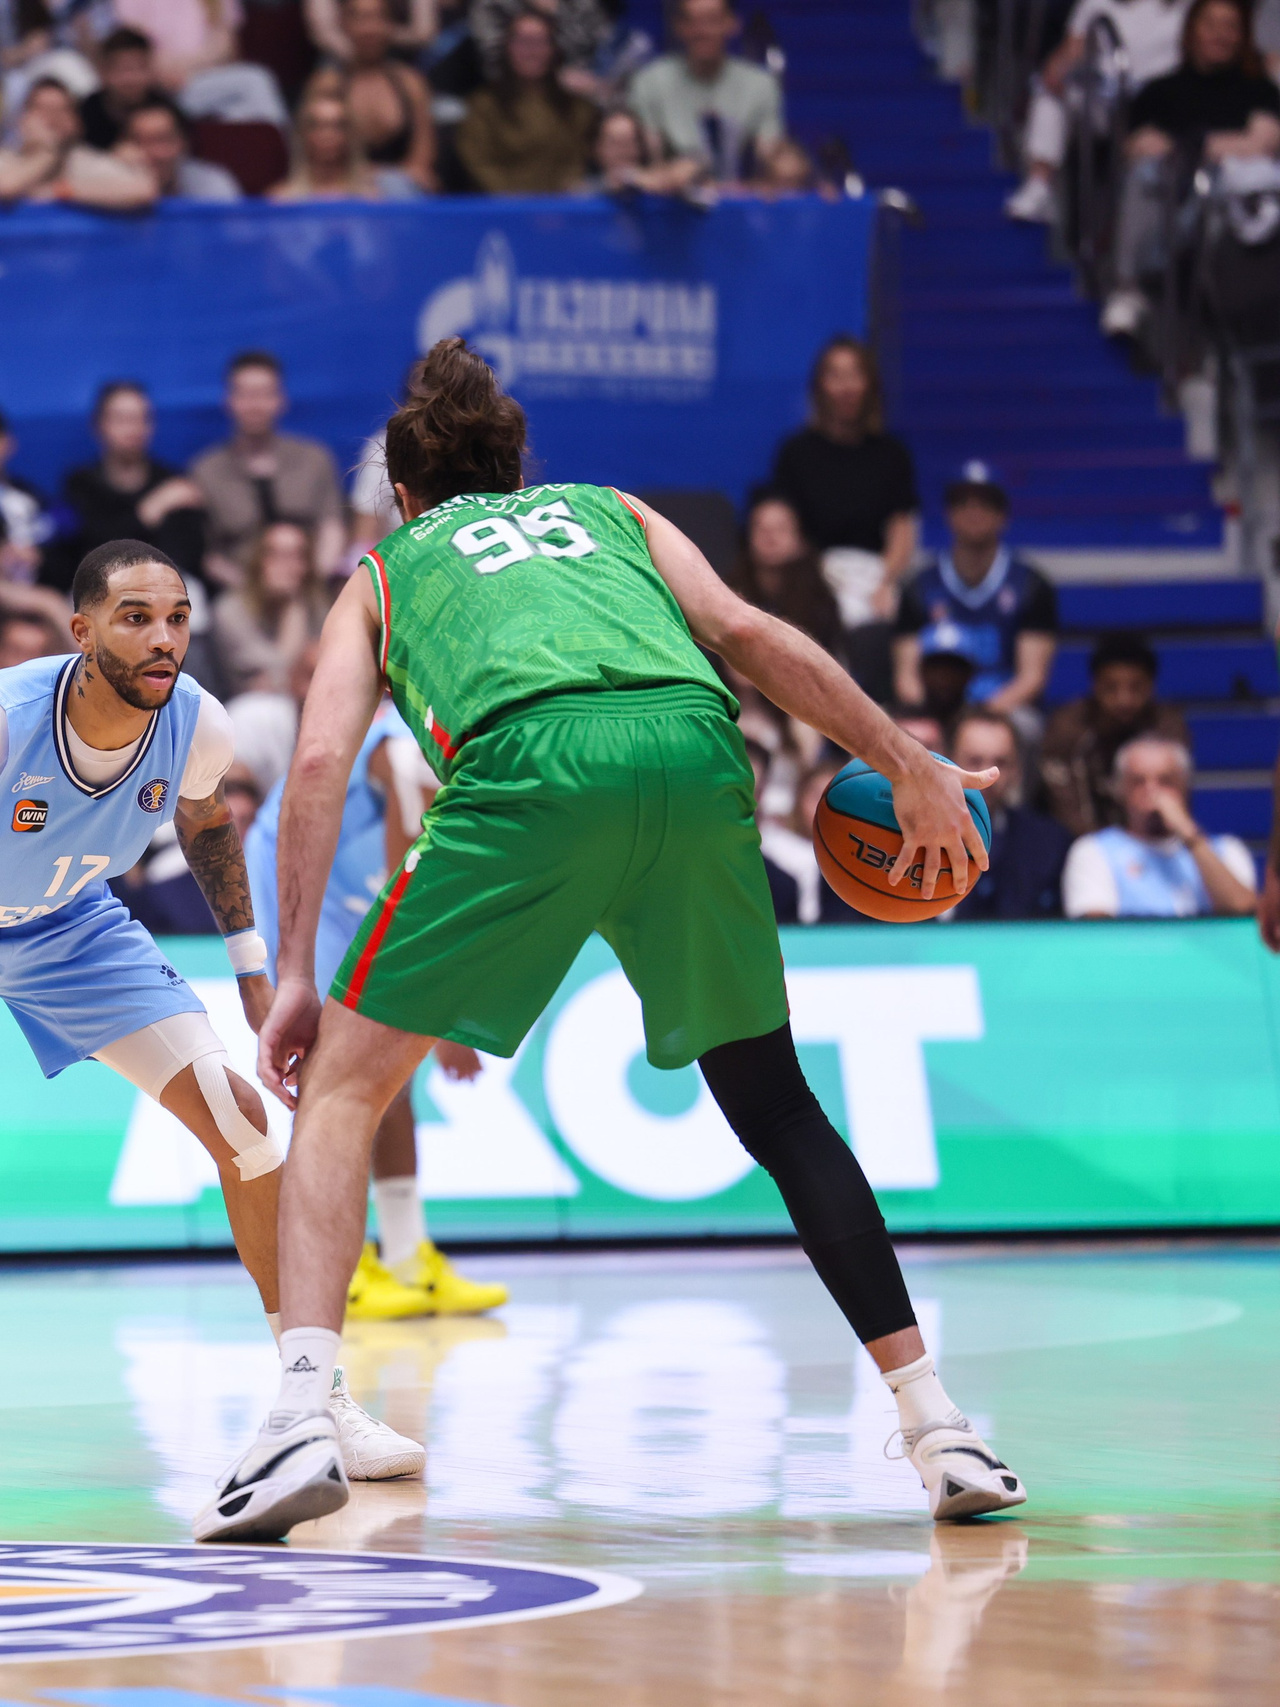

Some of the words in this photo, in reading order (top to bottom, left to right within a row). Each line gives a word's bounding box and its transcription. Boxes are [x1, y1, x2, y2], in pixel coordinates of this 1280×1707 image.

[448, 496, 601, 578] 95
[21, 811, 47, 822] WIN
[43, 855, 111, 898] 17
